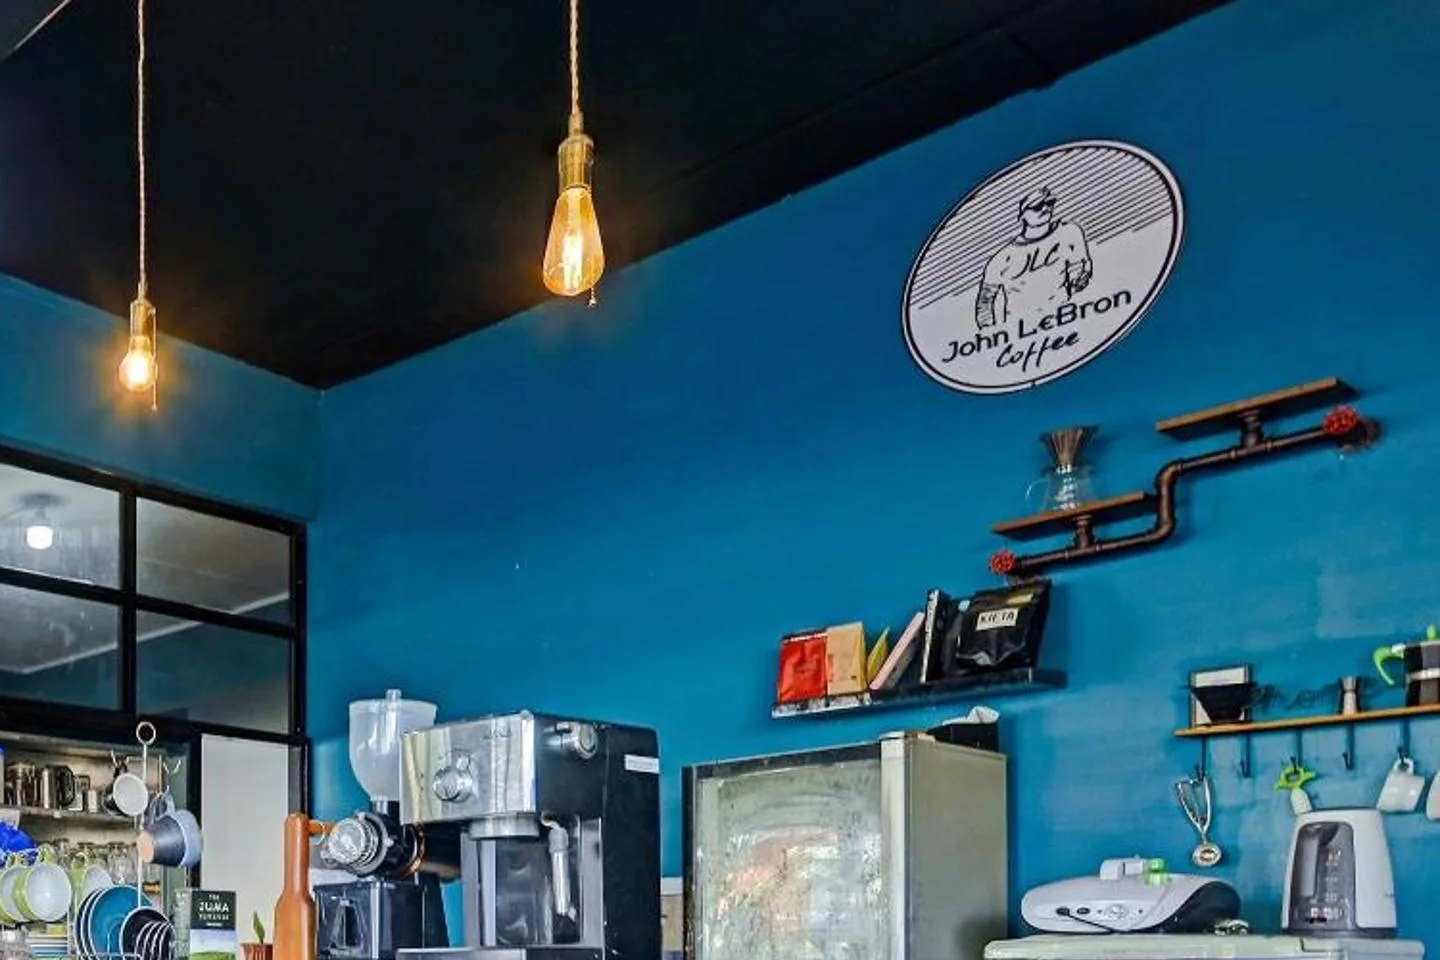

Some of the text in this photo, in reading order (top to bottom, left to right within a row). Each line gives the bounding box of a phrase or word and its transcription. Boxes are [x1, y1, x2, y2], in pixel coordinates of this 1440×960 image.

[1012, 243, 1060, 280] JLC
[942, 289, 1132, 363] John LeBron
[995, 331, 1080, 373] Coffee
